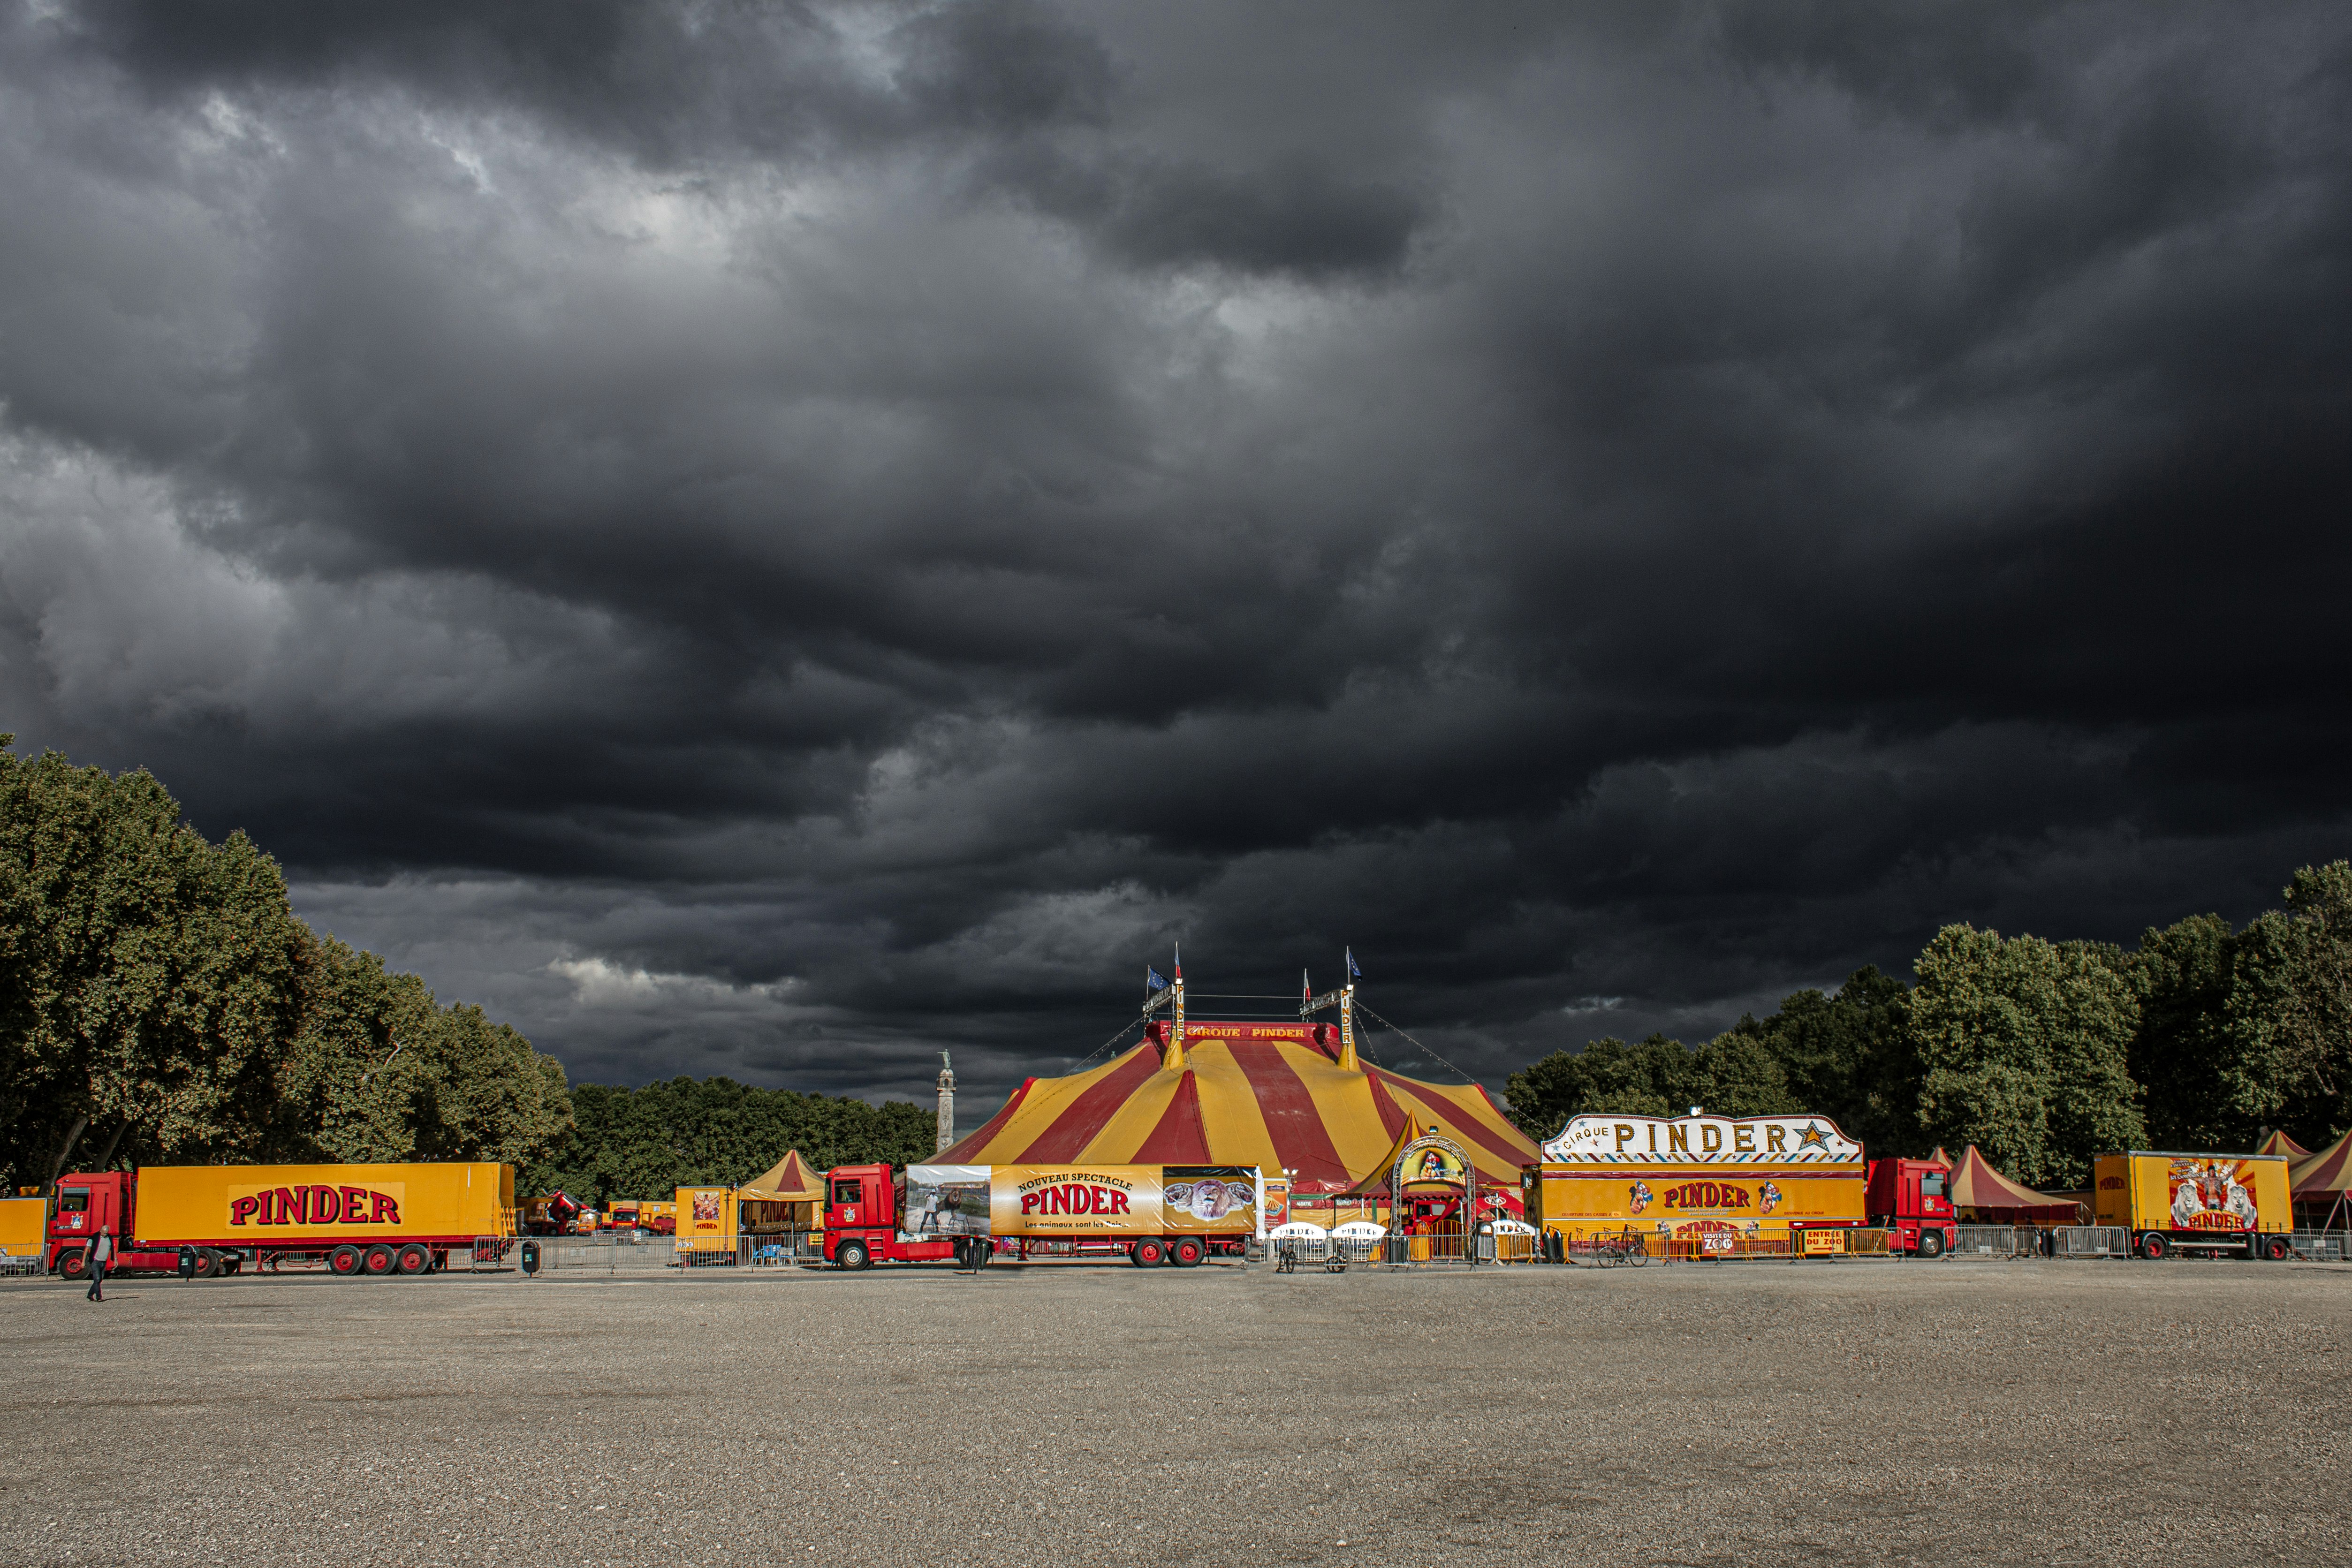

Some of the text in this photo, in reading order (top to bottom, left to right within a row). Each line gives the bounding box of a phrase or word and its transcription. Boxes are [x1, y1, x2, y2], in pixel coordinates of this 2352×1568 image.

[1341, 990, 1350, 1042] PINDER
[1187, 1027, 1305, 1037] CIRQUE PINDER
[1563, 1124, 1788, 1152] CIRQUE PINDER
[1017, 1173, 1133, 1192] NOUVEAU SPECTACLE
[2099, 1176, 2125, 1190] PINDER
[230, 1185, 401, 1225] PINDER
[1021, 1184, 1130, 1215] PINDER
[1664, 1182, 1750, 1208] PINDER
[761, 1201, 792, 1222] PINDE
[2188, 1212, 2244, 1228] PINDER
[1705, 1238, 1733, 1250] ZOO
